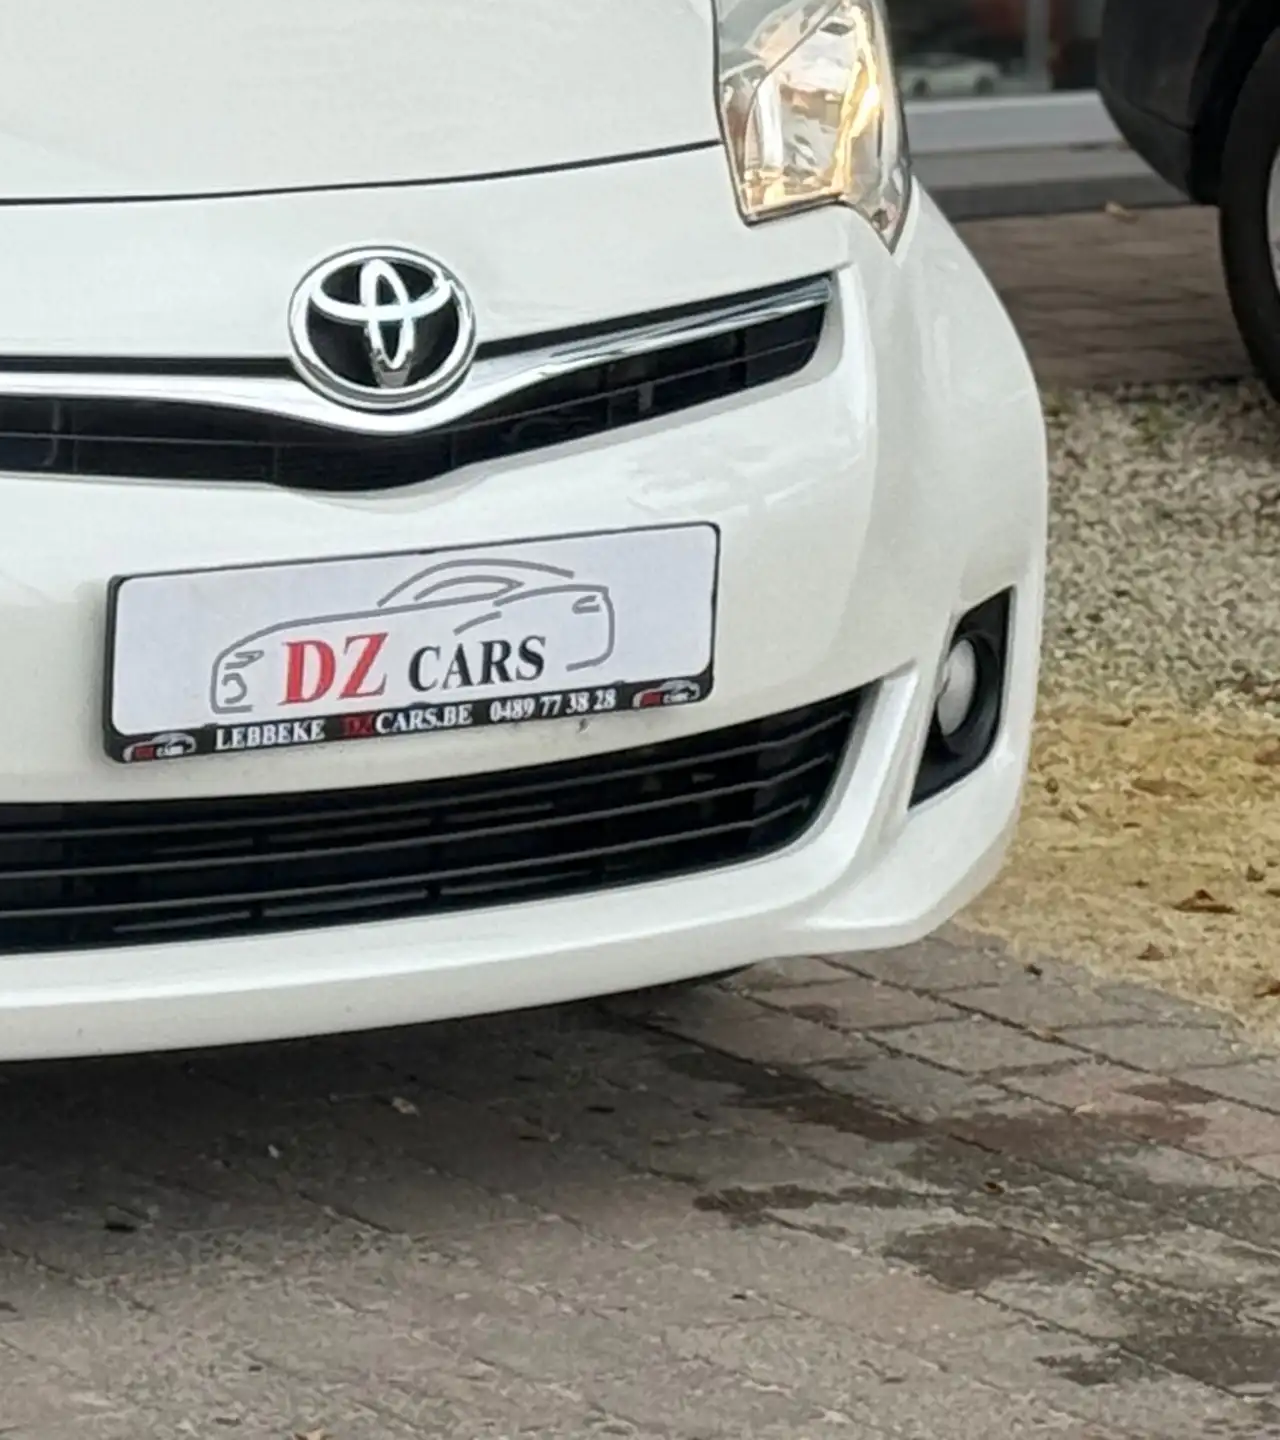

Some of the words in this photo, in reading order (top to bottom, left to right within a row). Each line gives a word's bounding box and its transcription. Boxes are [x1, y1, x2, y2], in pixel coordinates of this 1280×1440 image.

[278, 632, 389, 706] DZ
[408, 635, 547, 692] CARS
[215, 718, 326, 751] LEBBEKE
[489, 697, 536, 723] 0489
[539, 693, 563, 717] 77
[565, 690, 590, 714] 38
